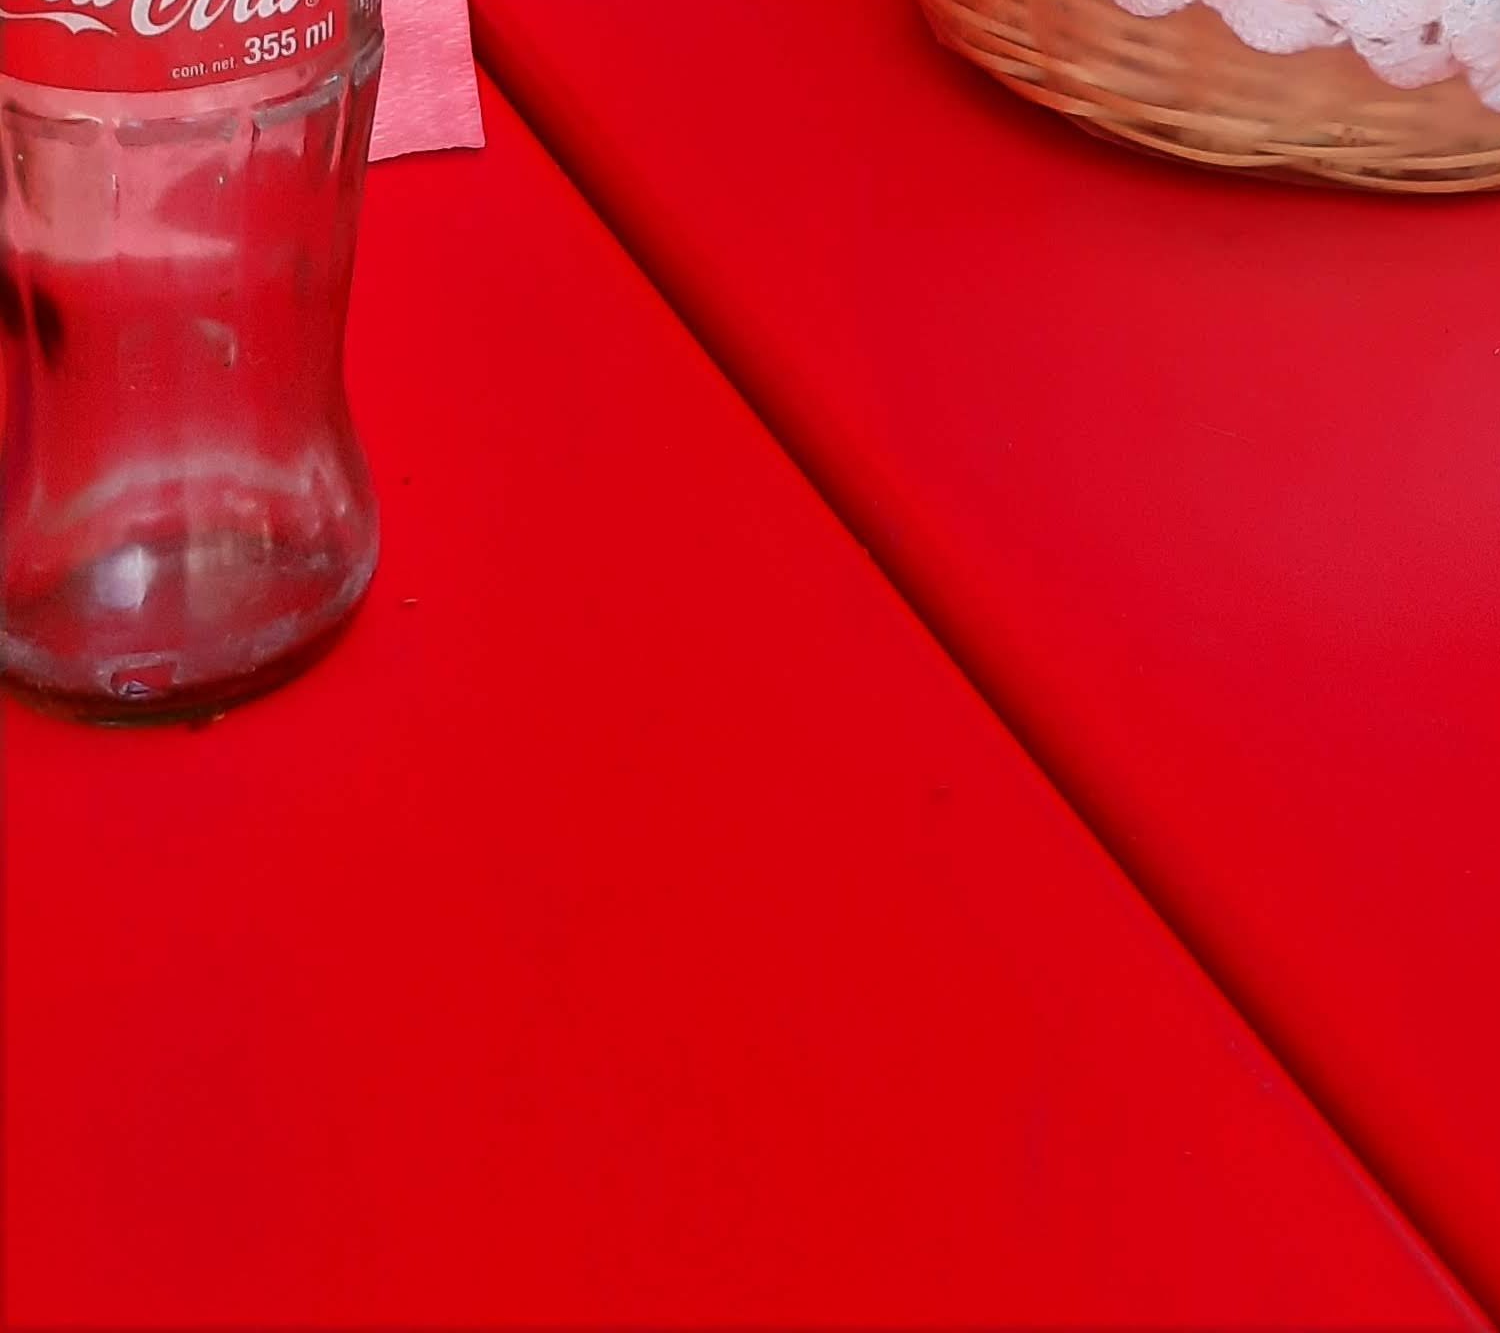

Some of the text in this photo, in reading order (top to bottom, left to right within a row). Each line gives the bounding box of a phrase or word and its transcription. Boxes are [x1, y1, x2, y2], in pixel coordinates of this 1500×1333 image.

[172, 11, 336, 80] cont. net. 355 ml
